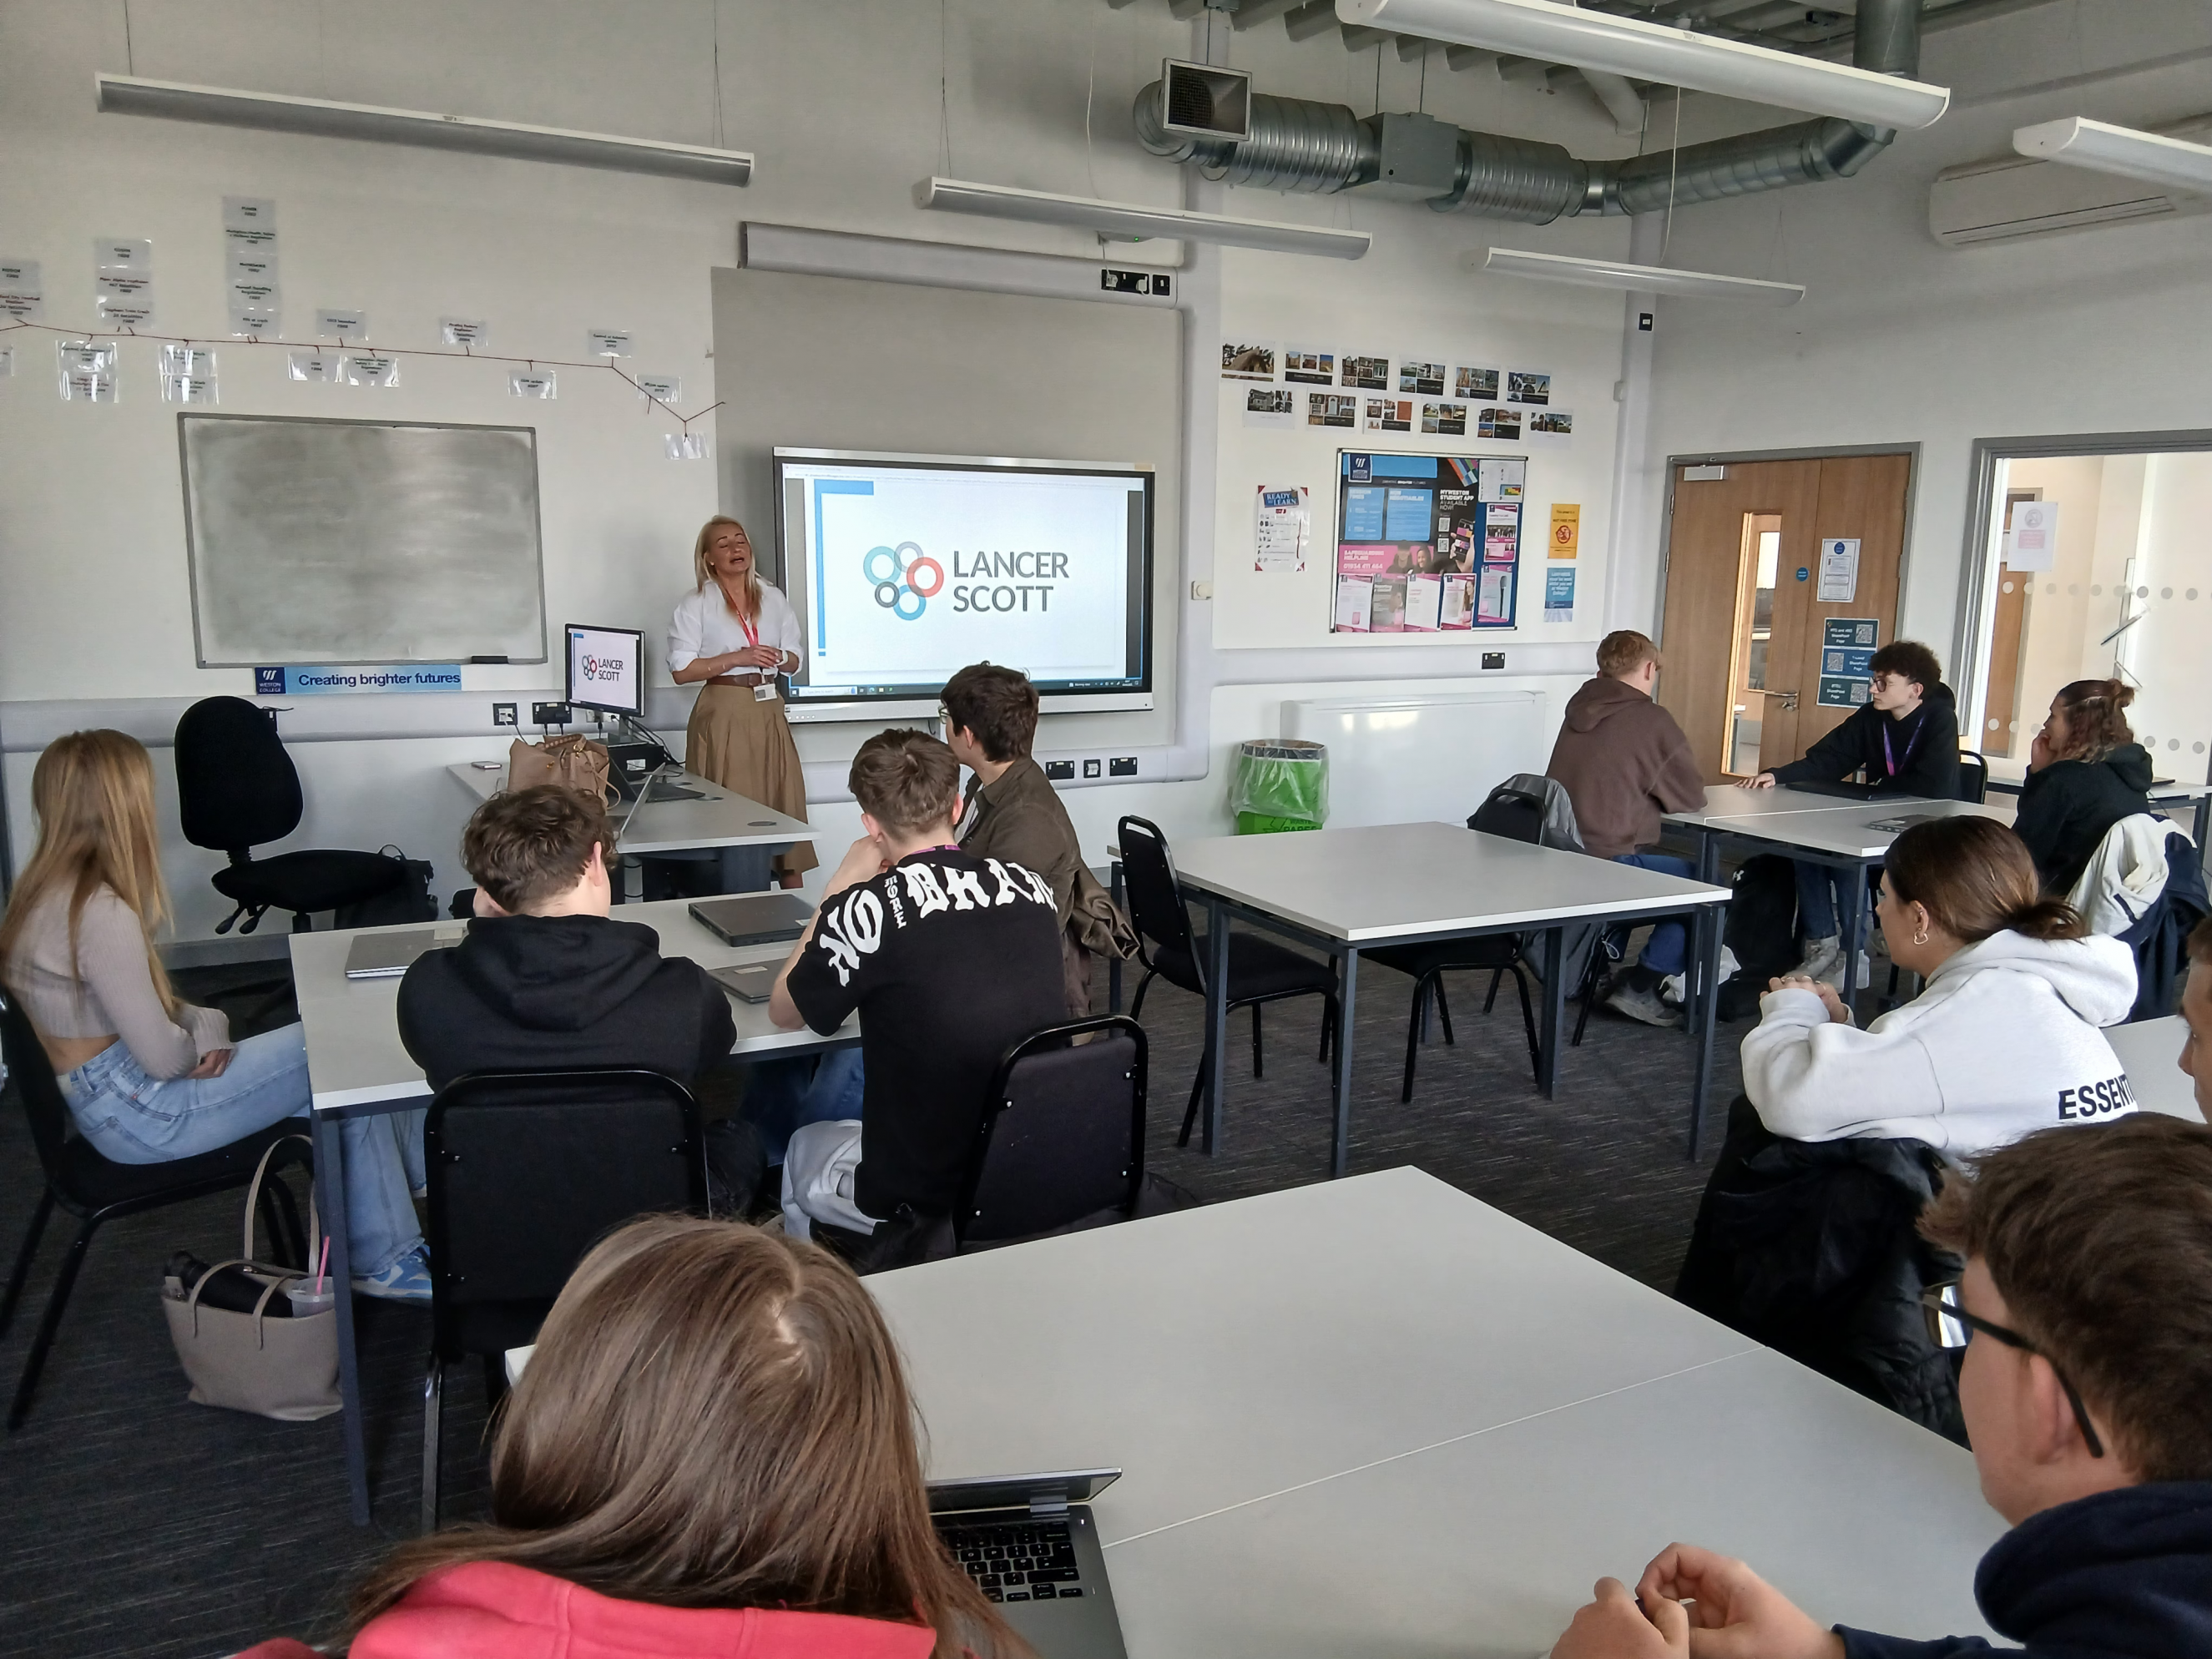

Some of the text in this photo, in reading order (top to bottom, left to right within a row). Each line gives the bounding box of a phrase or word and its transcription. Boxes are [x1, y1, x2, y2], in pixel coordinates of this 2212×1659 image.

[954, 551, 1069, 578] LANCER
[953, 585, 1053, 612] SCOTT
[598, 658, 624, 671] LANCER
[298, 672, 462, 687] Creating brighter futures
[598, 669, 620, 682] SCOTT
[820, 890, 883, 987] NO
[885, 875, 907, 929] MORE
